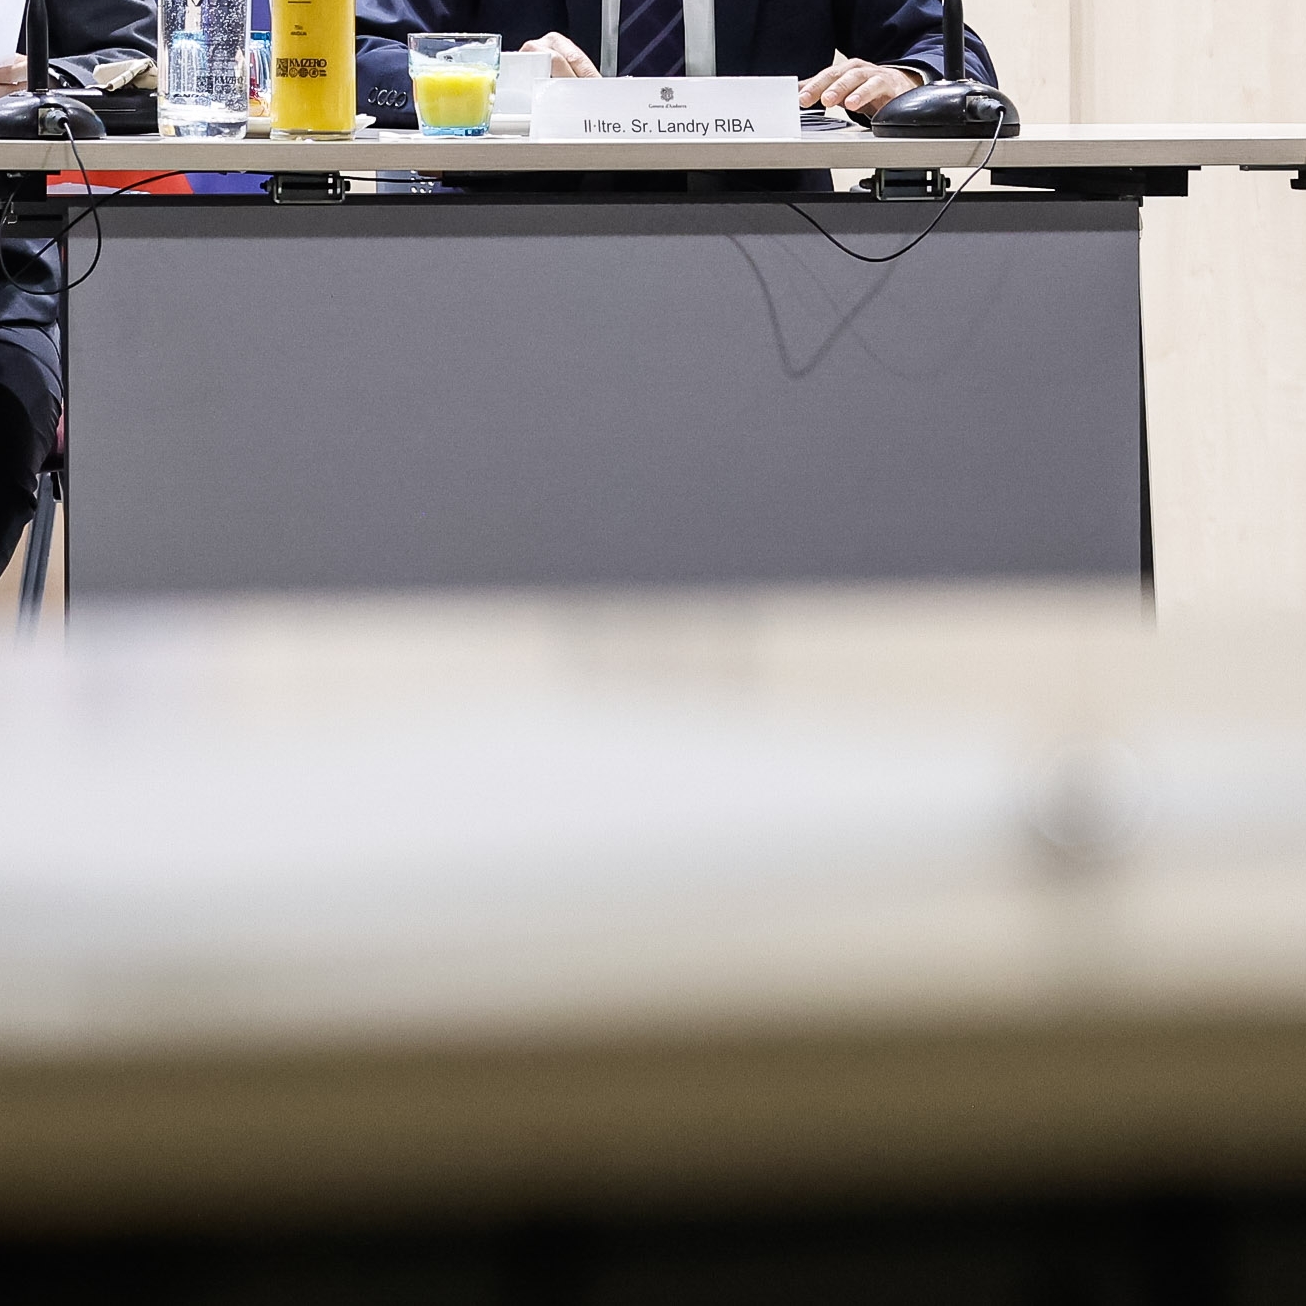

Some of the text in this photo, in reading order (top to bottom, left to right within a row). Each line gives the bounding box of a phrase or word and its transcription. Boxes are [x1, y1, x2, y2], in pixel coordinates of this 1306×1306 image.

[289, 58, 328, 68] KMZERO
[631, 119, 653, 133] Sr.
[657, 119, 710, 136] Landry
[715, 118, 755, 133] RIBA
